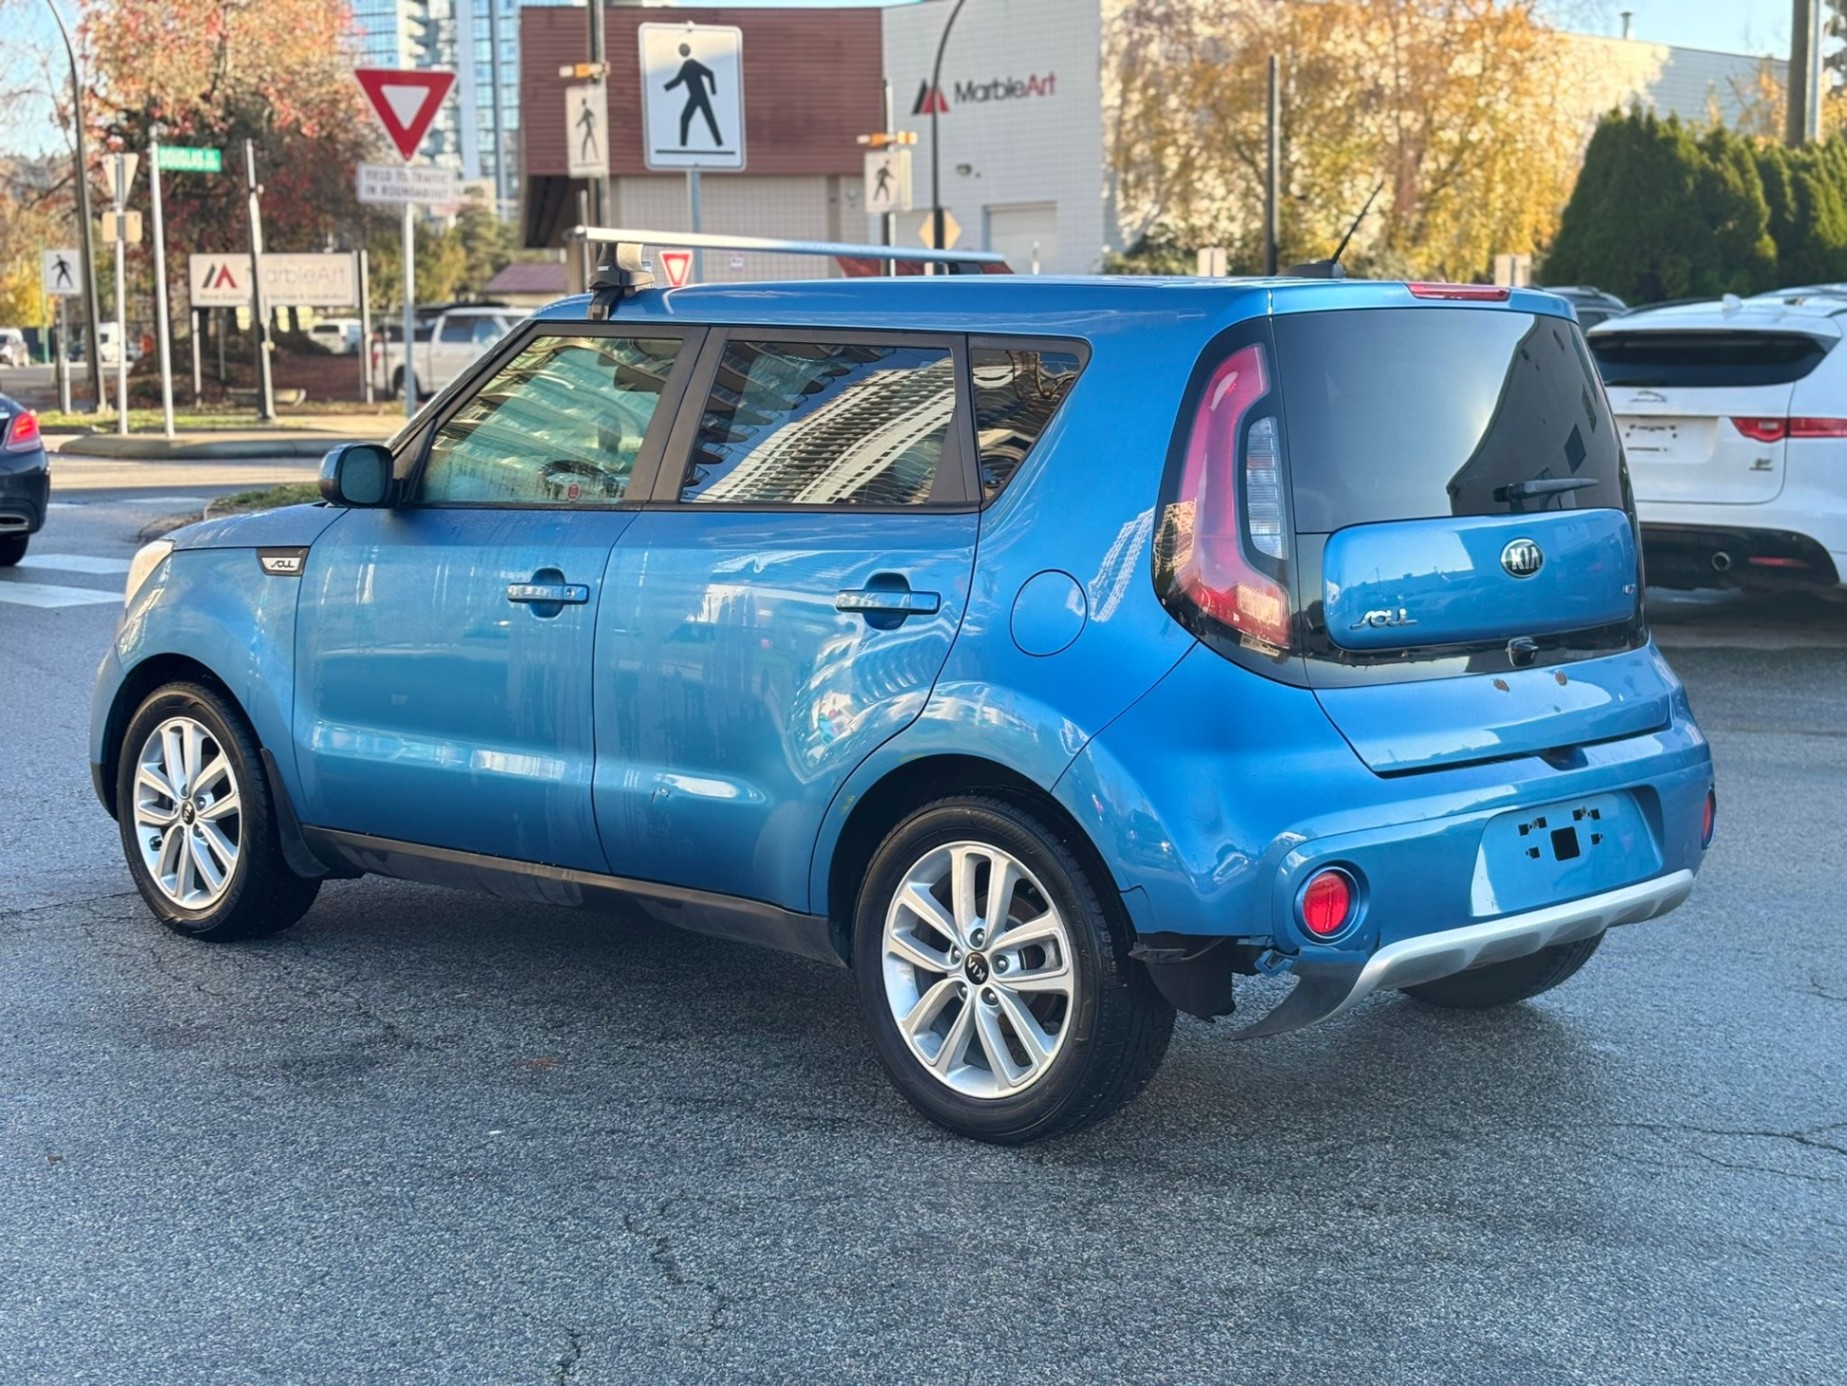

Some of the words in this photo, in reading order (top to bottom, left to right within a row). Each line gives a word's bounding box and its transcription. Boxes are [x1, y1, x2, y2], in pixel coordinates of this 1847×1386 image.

[954, 71, 1056, 104] MarbleArt
[1509, 546, 1540, 571] KIA
[1350, 608, 1418, 629] SOUL
[967, 957, 985, 981] KIA
